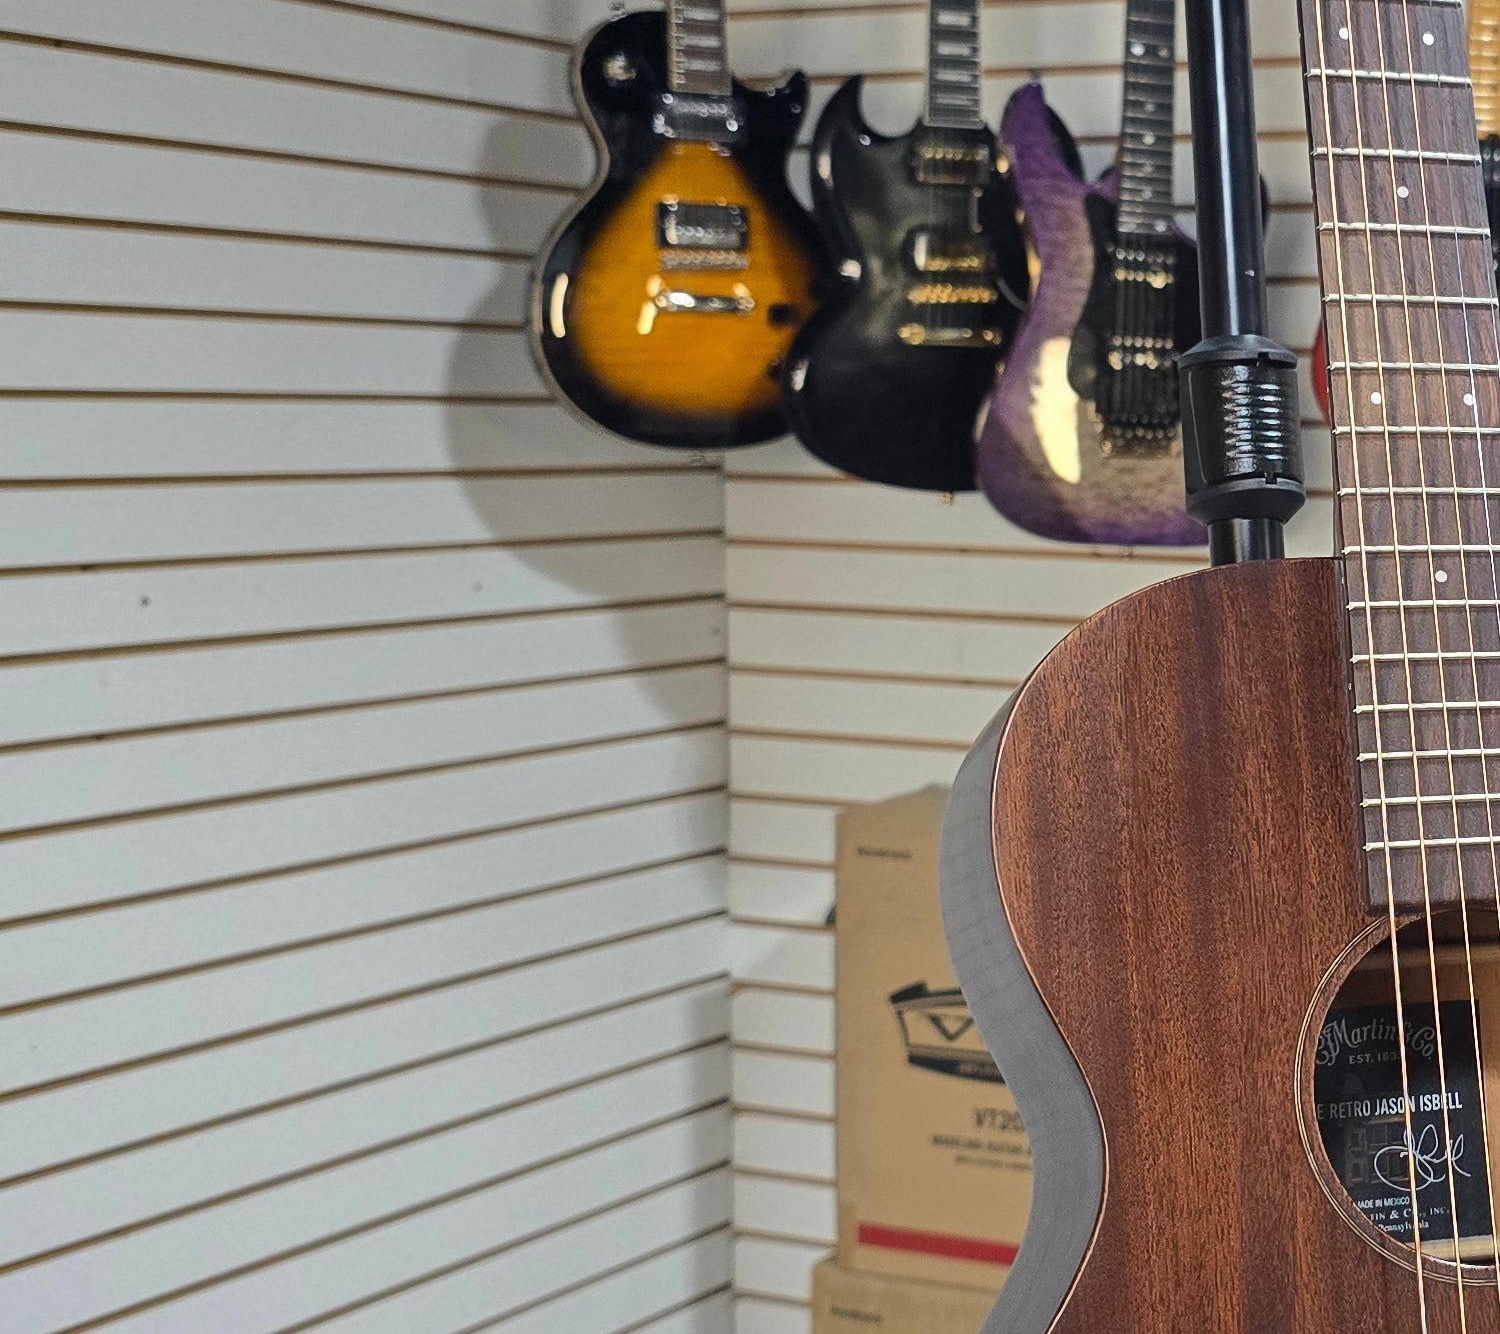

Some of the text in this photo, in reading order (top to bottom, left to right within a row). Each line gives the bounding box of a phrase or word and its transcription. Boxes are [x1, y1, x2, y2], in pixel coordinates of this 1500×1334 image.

[1329, 1099, 1371, 1118] RETRO
[1375, 1095, 1416, 1115] JASON
[1420, 1091, 1463, 1112] ISBELL
[1375, 1198, 1383, 1208] IN
[1383, 1196, 1411, 1207] MEXICO
